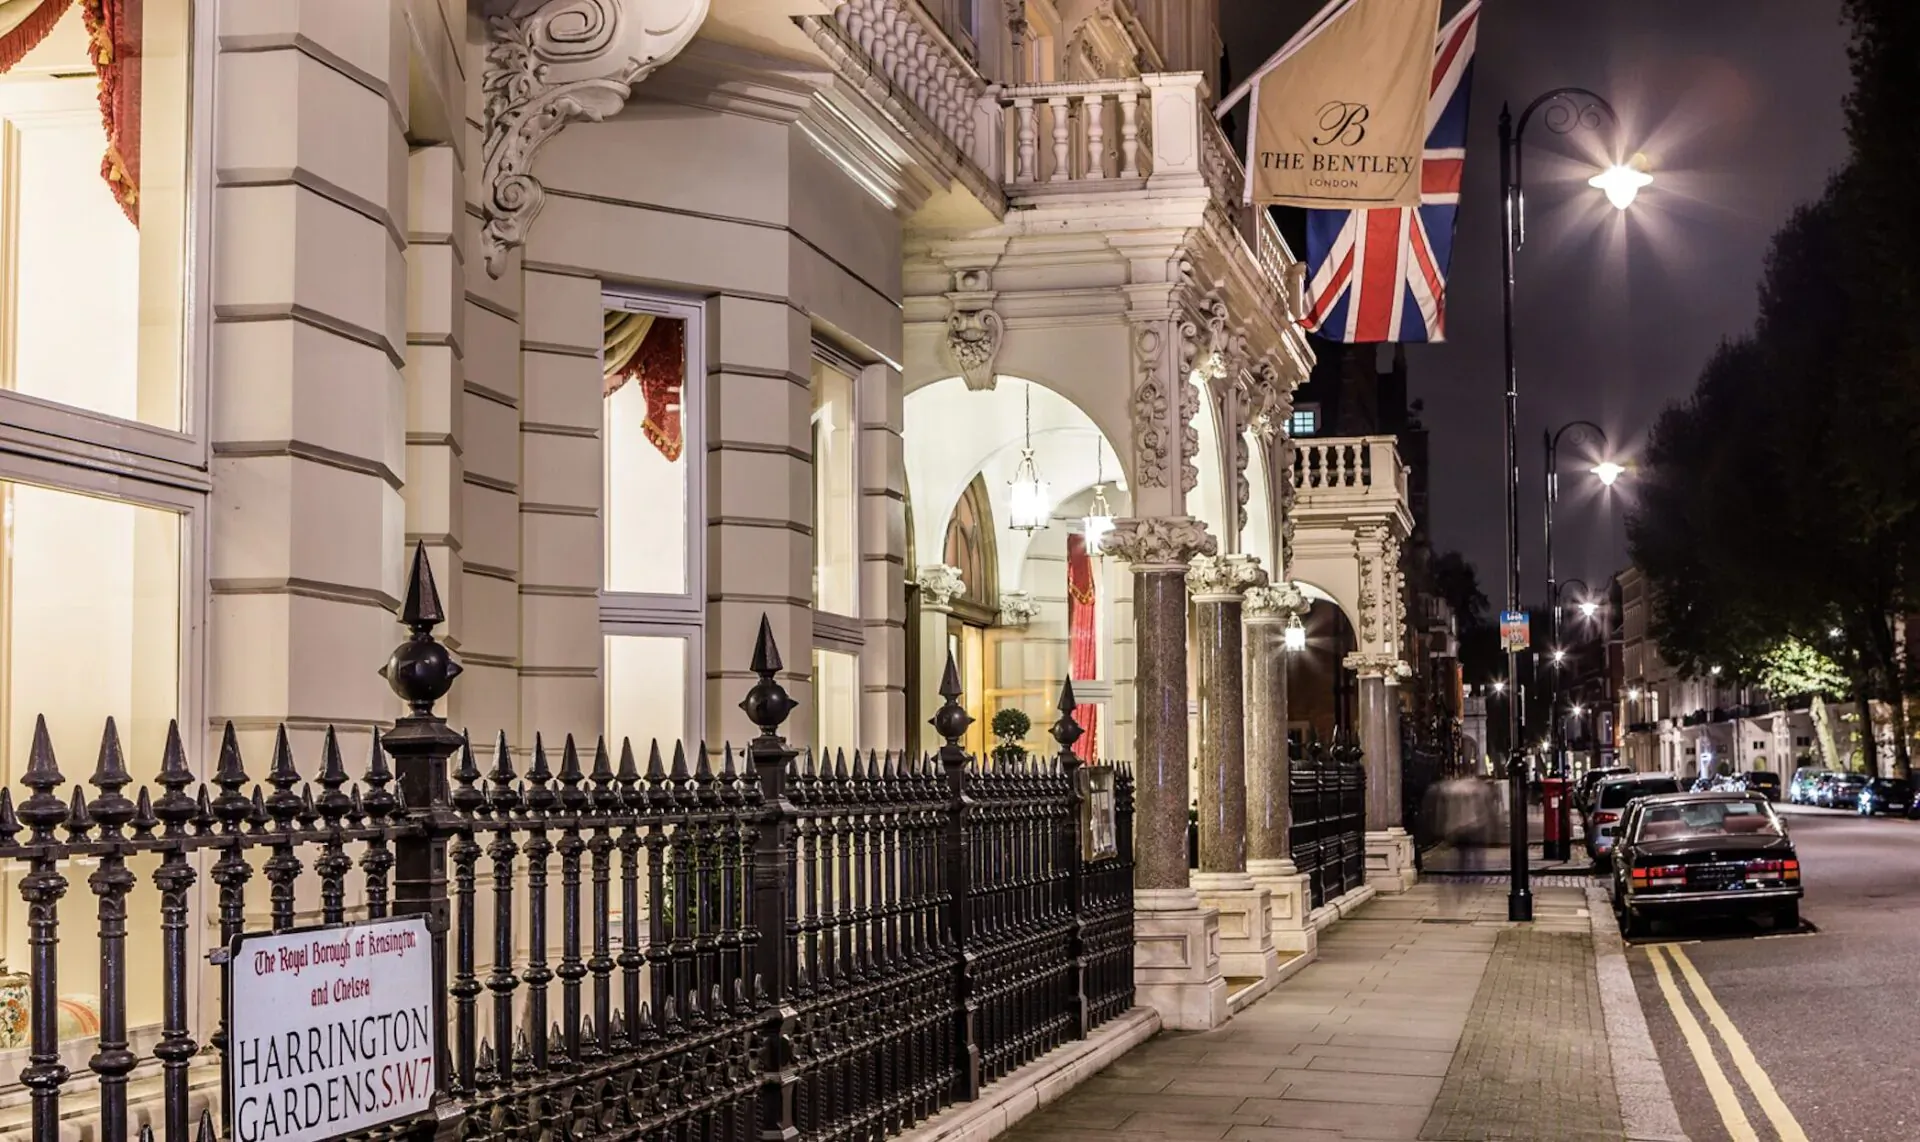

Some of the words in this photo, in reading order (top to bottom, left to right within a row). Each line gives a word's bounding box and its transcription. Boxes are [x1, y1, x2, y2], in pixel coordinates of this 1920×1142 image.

[1312, 100, 1370, 147] B
[1261, 151, 1305, 170] THE
[1312, 154, 1413, 174] BENTLEY
[1309, 178, 1358, 188] LONDON
[255, 949, 276, 975] The
[279, 946, 308, 976] Royal
[312, 939, 351, 968] Borough
[355, 934, 365, 958] of
[369, 928, 416, 956] Kensington
[311, 980, 329, 1007] and
[333, 976, 370, 1002] Chelsea
[239, 1004, 429, 1088] HARRINGTON
